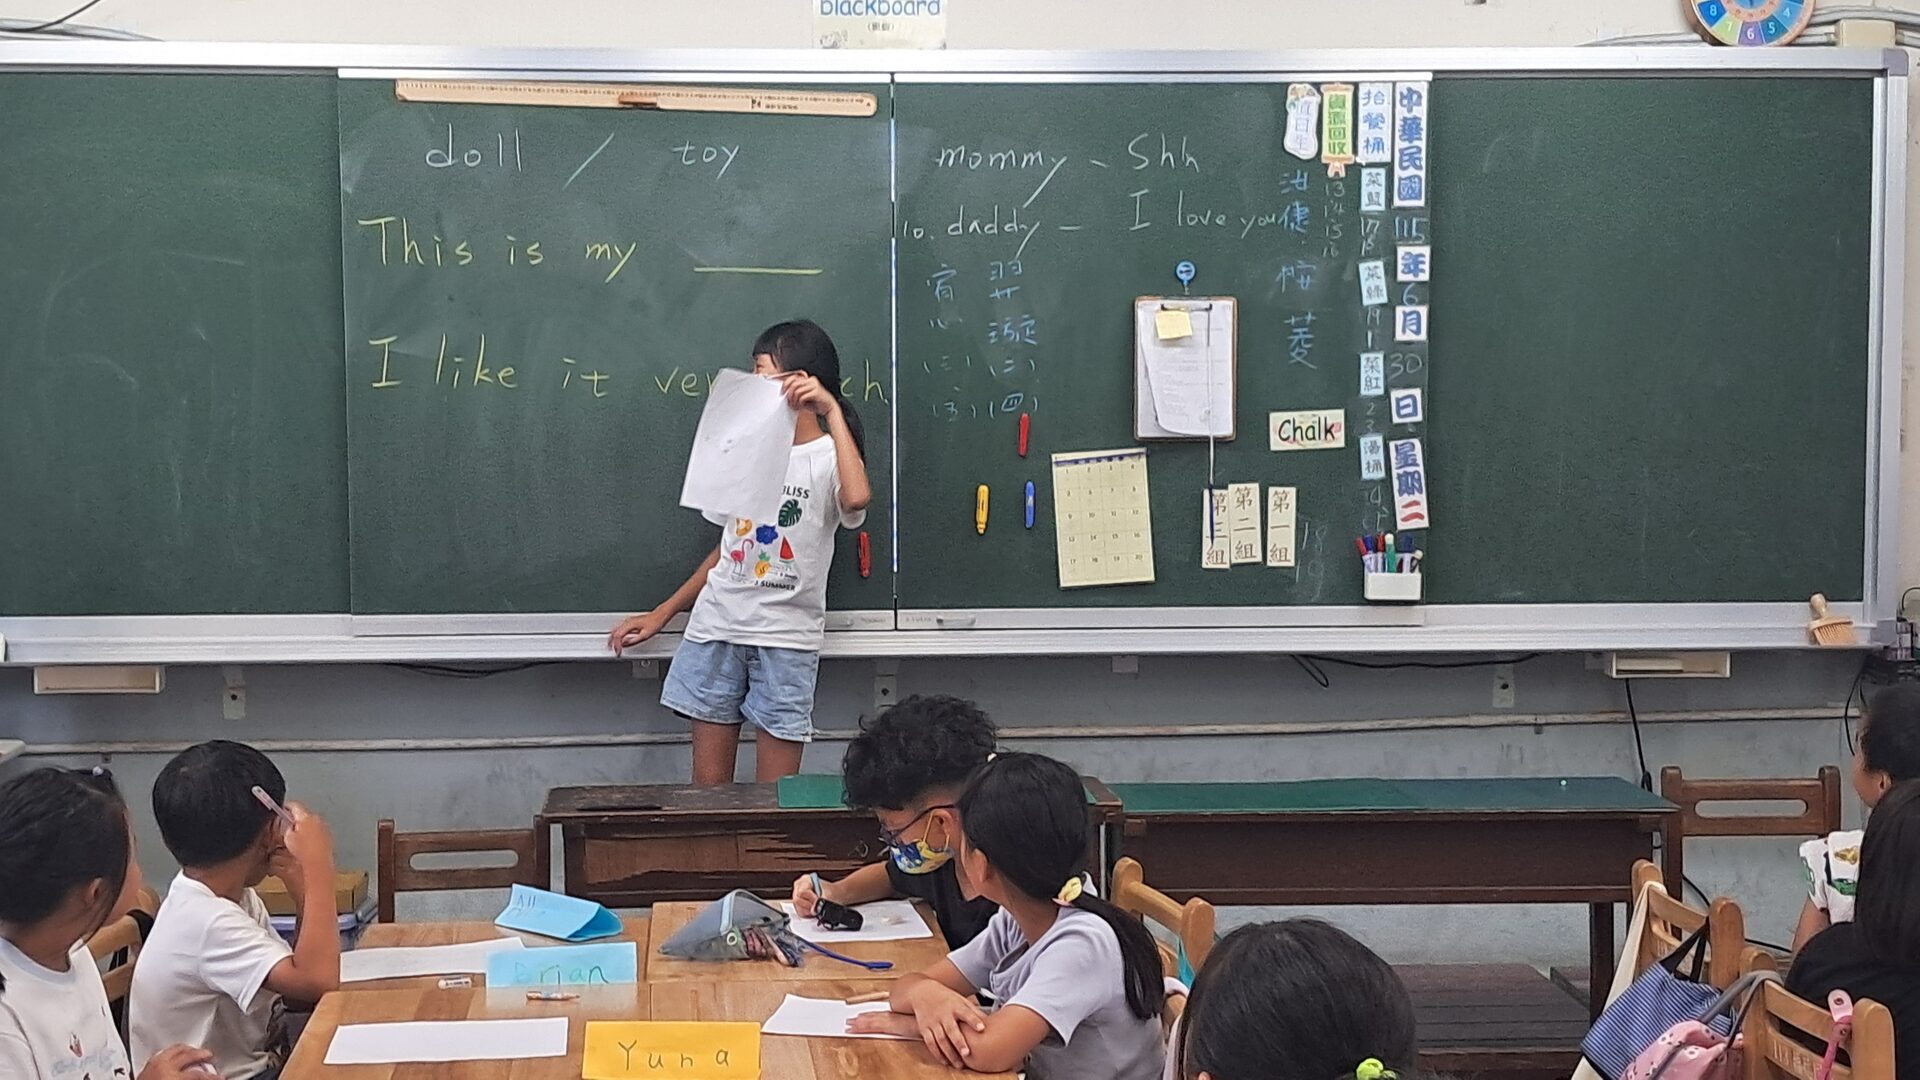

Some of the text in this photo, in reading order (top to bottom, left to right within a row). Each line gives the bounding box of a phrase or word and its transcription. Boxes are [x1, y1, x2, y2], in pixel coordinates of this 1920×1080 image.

[820, 0, 941, 16] blackboard
[1709, 5, 1717, 16] 8
[1783, 8, 1791, 18] 4
[1727, 22, 1732, 31] 7
[1746, 28, 1755, 40] 6
[1768, 22, 1776, 34] 5
[426, 123, 522, 171] doll
[673, 133, 739, 179] toy
[1398, 86, 1424, 201] 中華民國
[935, 145, 1068, 208] mommy
[1127, 133, 1199, 173] Shh
[947, 205, 1041, 260] daddy
[1129, 189, 1150, 231] I
[1177, 190, 1227, 227] love
[1240, 214, 1276, 239] you
[1395, 216, 1429, 241] 115
[358, 216, 638, 283] This is my
[1401, 251, 1426, 278] 年
[1403, 283, 1418, 306] 6
[1401, 310, 1421, 336] 月
[368, 336, 401, 388] I
[435, 332, 518, 388] like
[562, 358, 610, 397] it
[654, 366, 716, 399] ver
[1389, 352, 1423, 380] 30
[1395, 394, 1419, 419] 日
[1278, 417, 1336, 442] Chalk
[1363, 440, 1383, 473] 湯桶
[1395, 442, 1425, 522] 星期二
[1206, 493, 1228, 565] 第三組
[1234, 486, 1257, 560] 第二組
[1269, 490, 1291, 563] 第一組
[760, 580, 796, 591] SUMMER
[618, 1039, 730, 1071] Yuna
